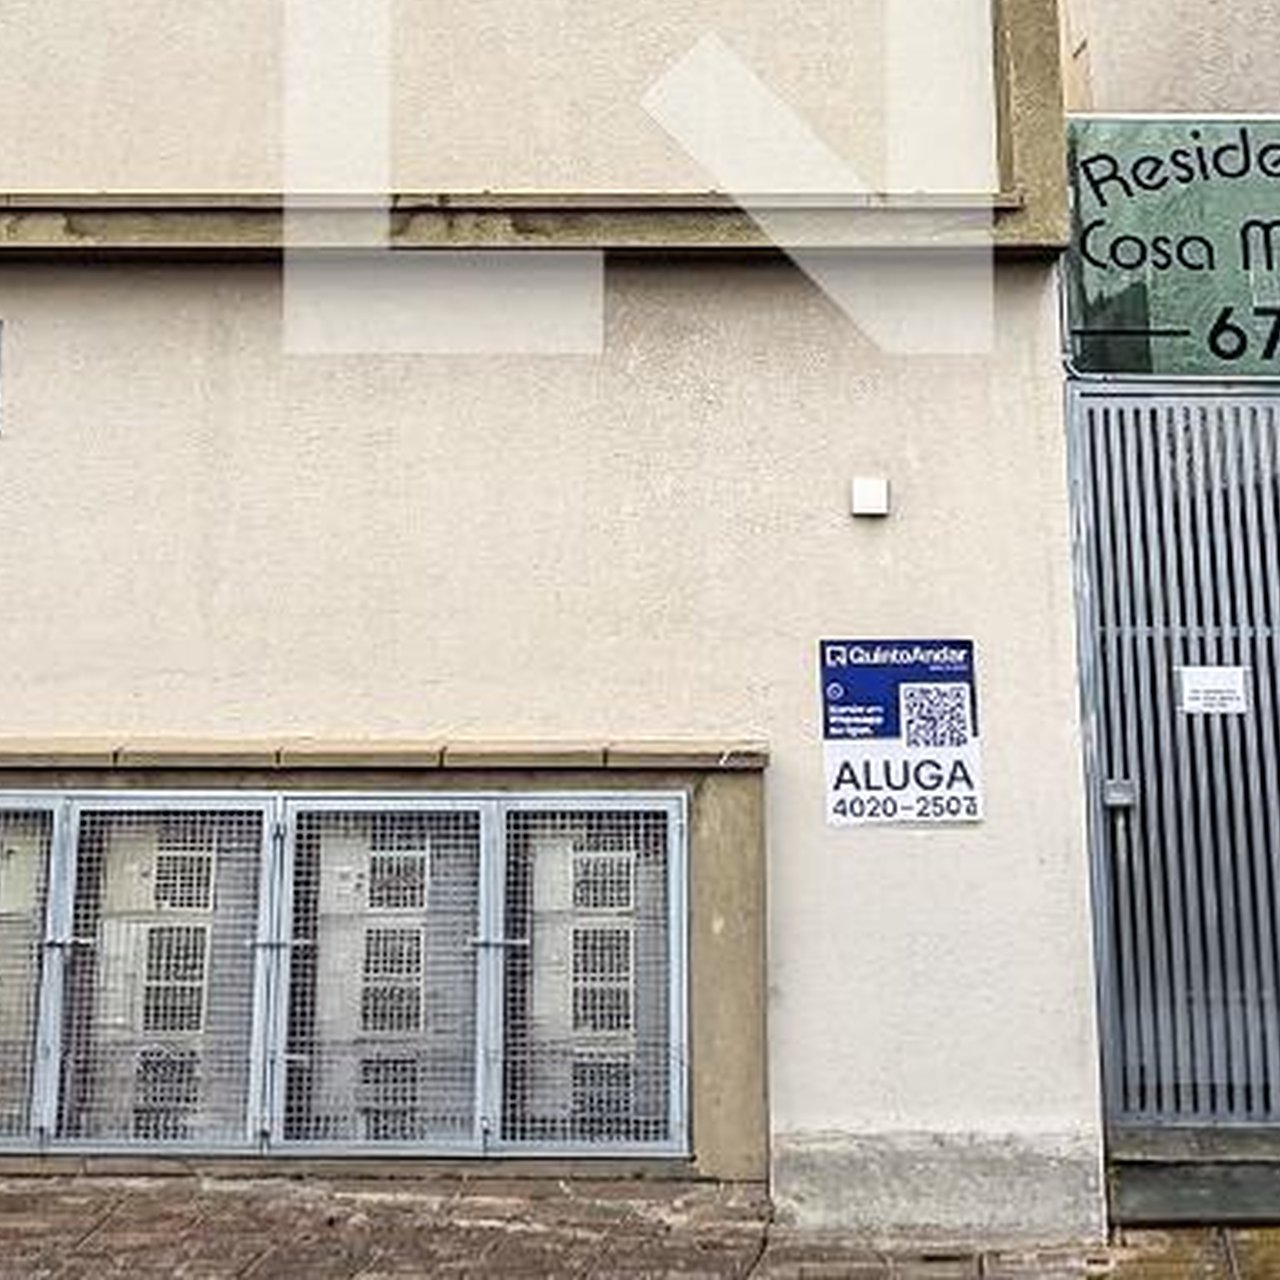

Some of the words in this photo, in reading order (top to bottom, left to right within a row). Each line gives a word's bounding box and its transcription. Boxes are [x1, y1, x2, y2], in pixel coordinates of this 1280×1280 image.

[1079, 219, 1217, 271] Cosa
[849, 646, 968, 664] QuintoAndar
[832, 759, 975, 791] ALUGA
